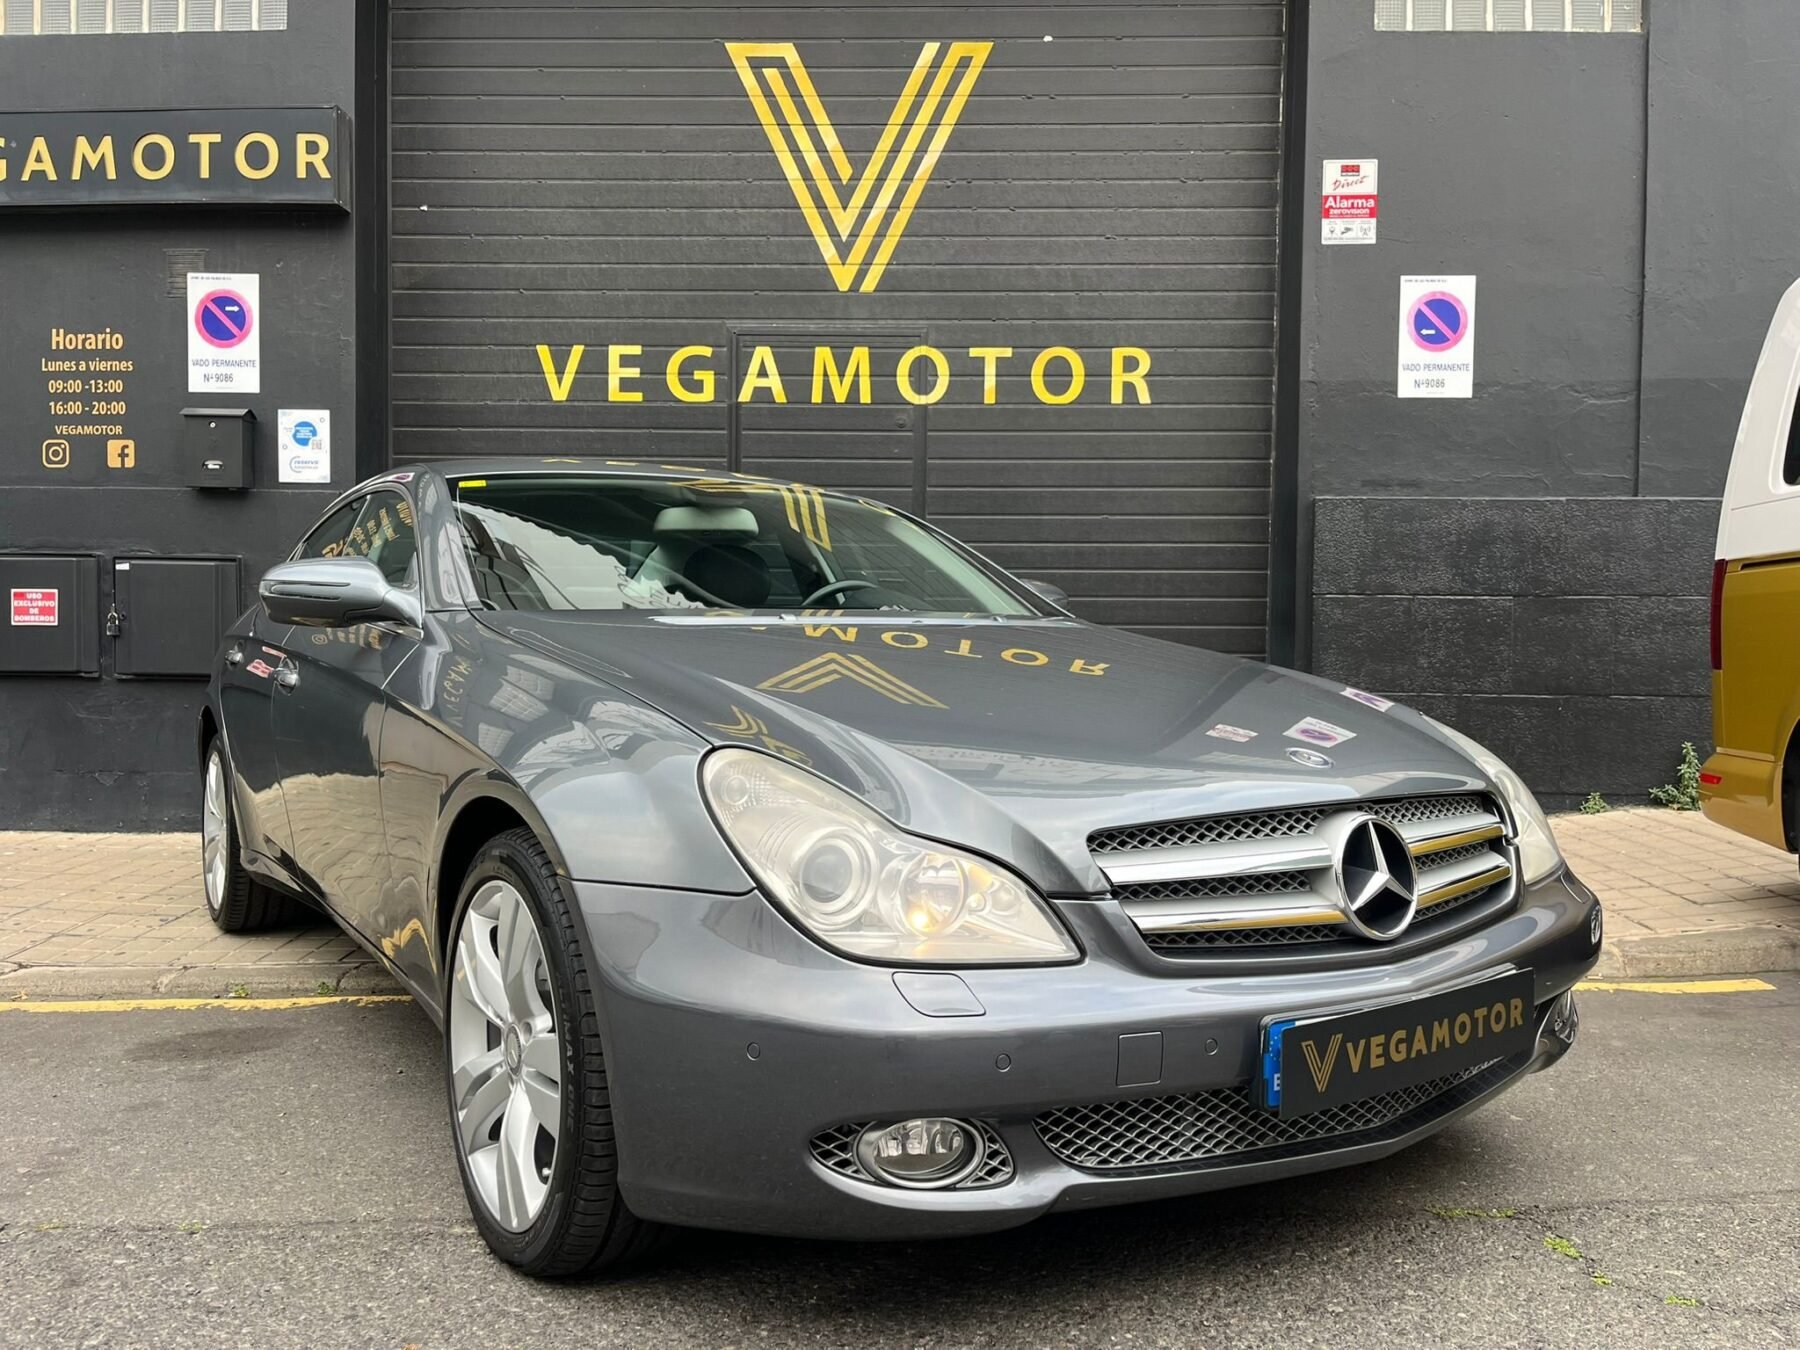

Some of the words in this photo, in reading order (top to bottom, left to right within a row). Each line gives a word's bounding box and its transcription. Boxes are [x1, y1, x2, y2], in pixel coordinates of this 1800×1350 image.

[0, 132, 332, 181] AMOTOR
[1325, 195, 1375, 208] Alarma
[51, 328, 124, 350] Horario
[41, 358, 76, 371] Lunes
[78, 361, 86, 371] a
[88, 357, 133, 371] viernes
[192, 359, 209, 367] VADO
[211, 359, 257, 368] PERMANENTE
[1402, 363, 1421, 372] VADO
[1423, 363, 1470, 372] PERMANENTE
[536, 345, 1152, 406] VEGAMOTOR
[48, 380, 82, 393] 09:00
[49, 401, 82, 415] 16:00
[91, 401, 126, 415] 20:00
[55, 425, 123, 435] VEGAMOTOR
[29, 607, 39, 615] DE
[1346, 998, 1523, 1073] VEGAMOTOR
